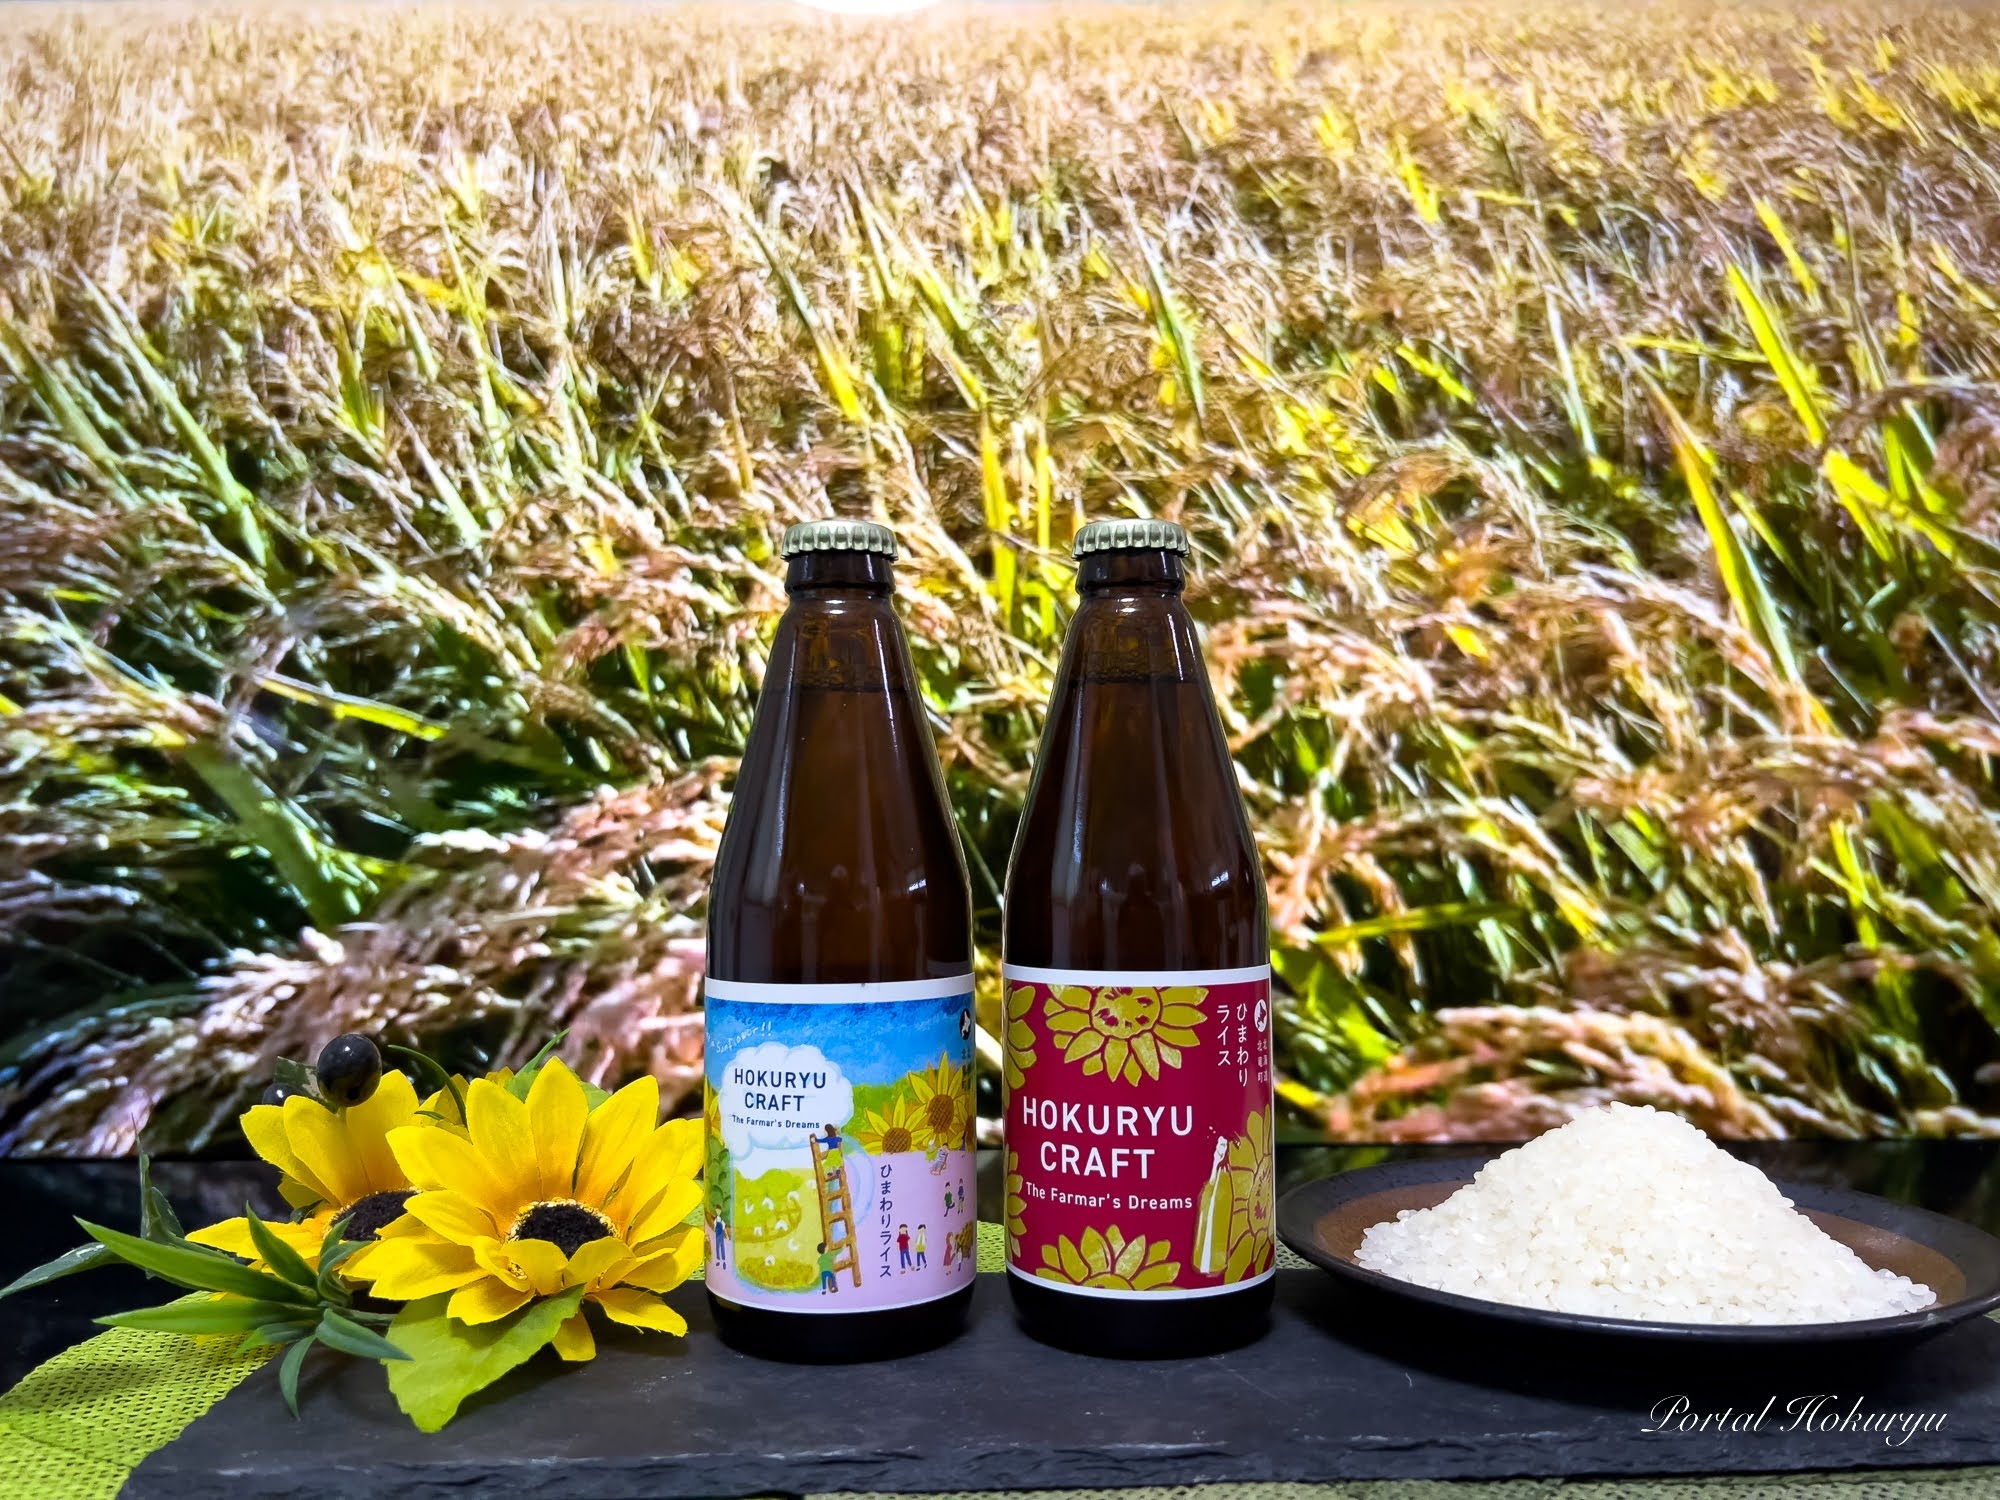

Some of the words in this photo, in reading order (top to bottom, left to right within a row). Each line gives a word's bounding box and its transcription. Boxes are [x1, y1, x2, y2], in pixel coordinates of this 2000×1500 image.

[1216, 1004, 1231, 1066] ライス
[1236, 1003, 1249, 1087] ひまわり
[734, 1068, 826, 1089] HOKURYU
[744, 1092, 805, 1111] CRAFT
[1023, 1096, 1193, 1136] HOKURYU
[732, 1114, 744, 1124] The
[746, 1116, 782, 1128] Farmar's
[785, 1120, 820, 1129] Dreams
[1040, 1141, 1155, 1179] CRAFT
[1026, 1181, 1046, 1199] The
[1051, 1187, 1121, 1209] Farmar's
[1128, 1195, 1193, 1210] Dreams
[880, 1164, 893, 1278] ひまわりライス
